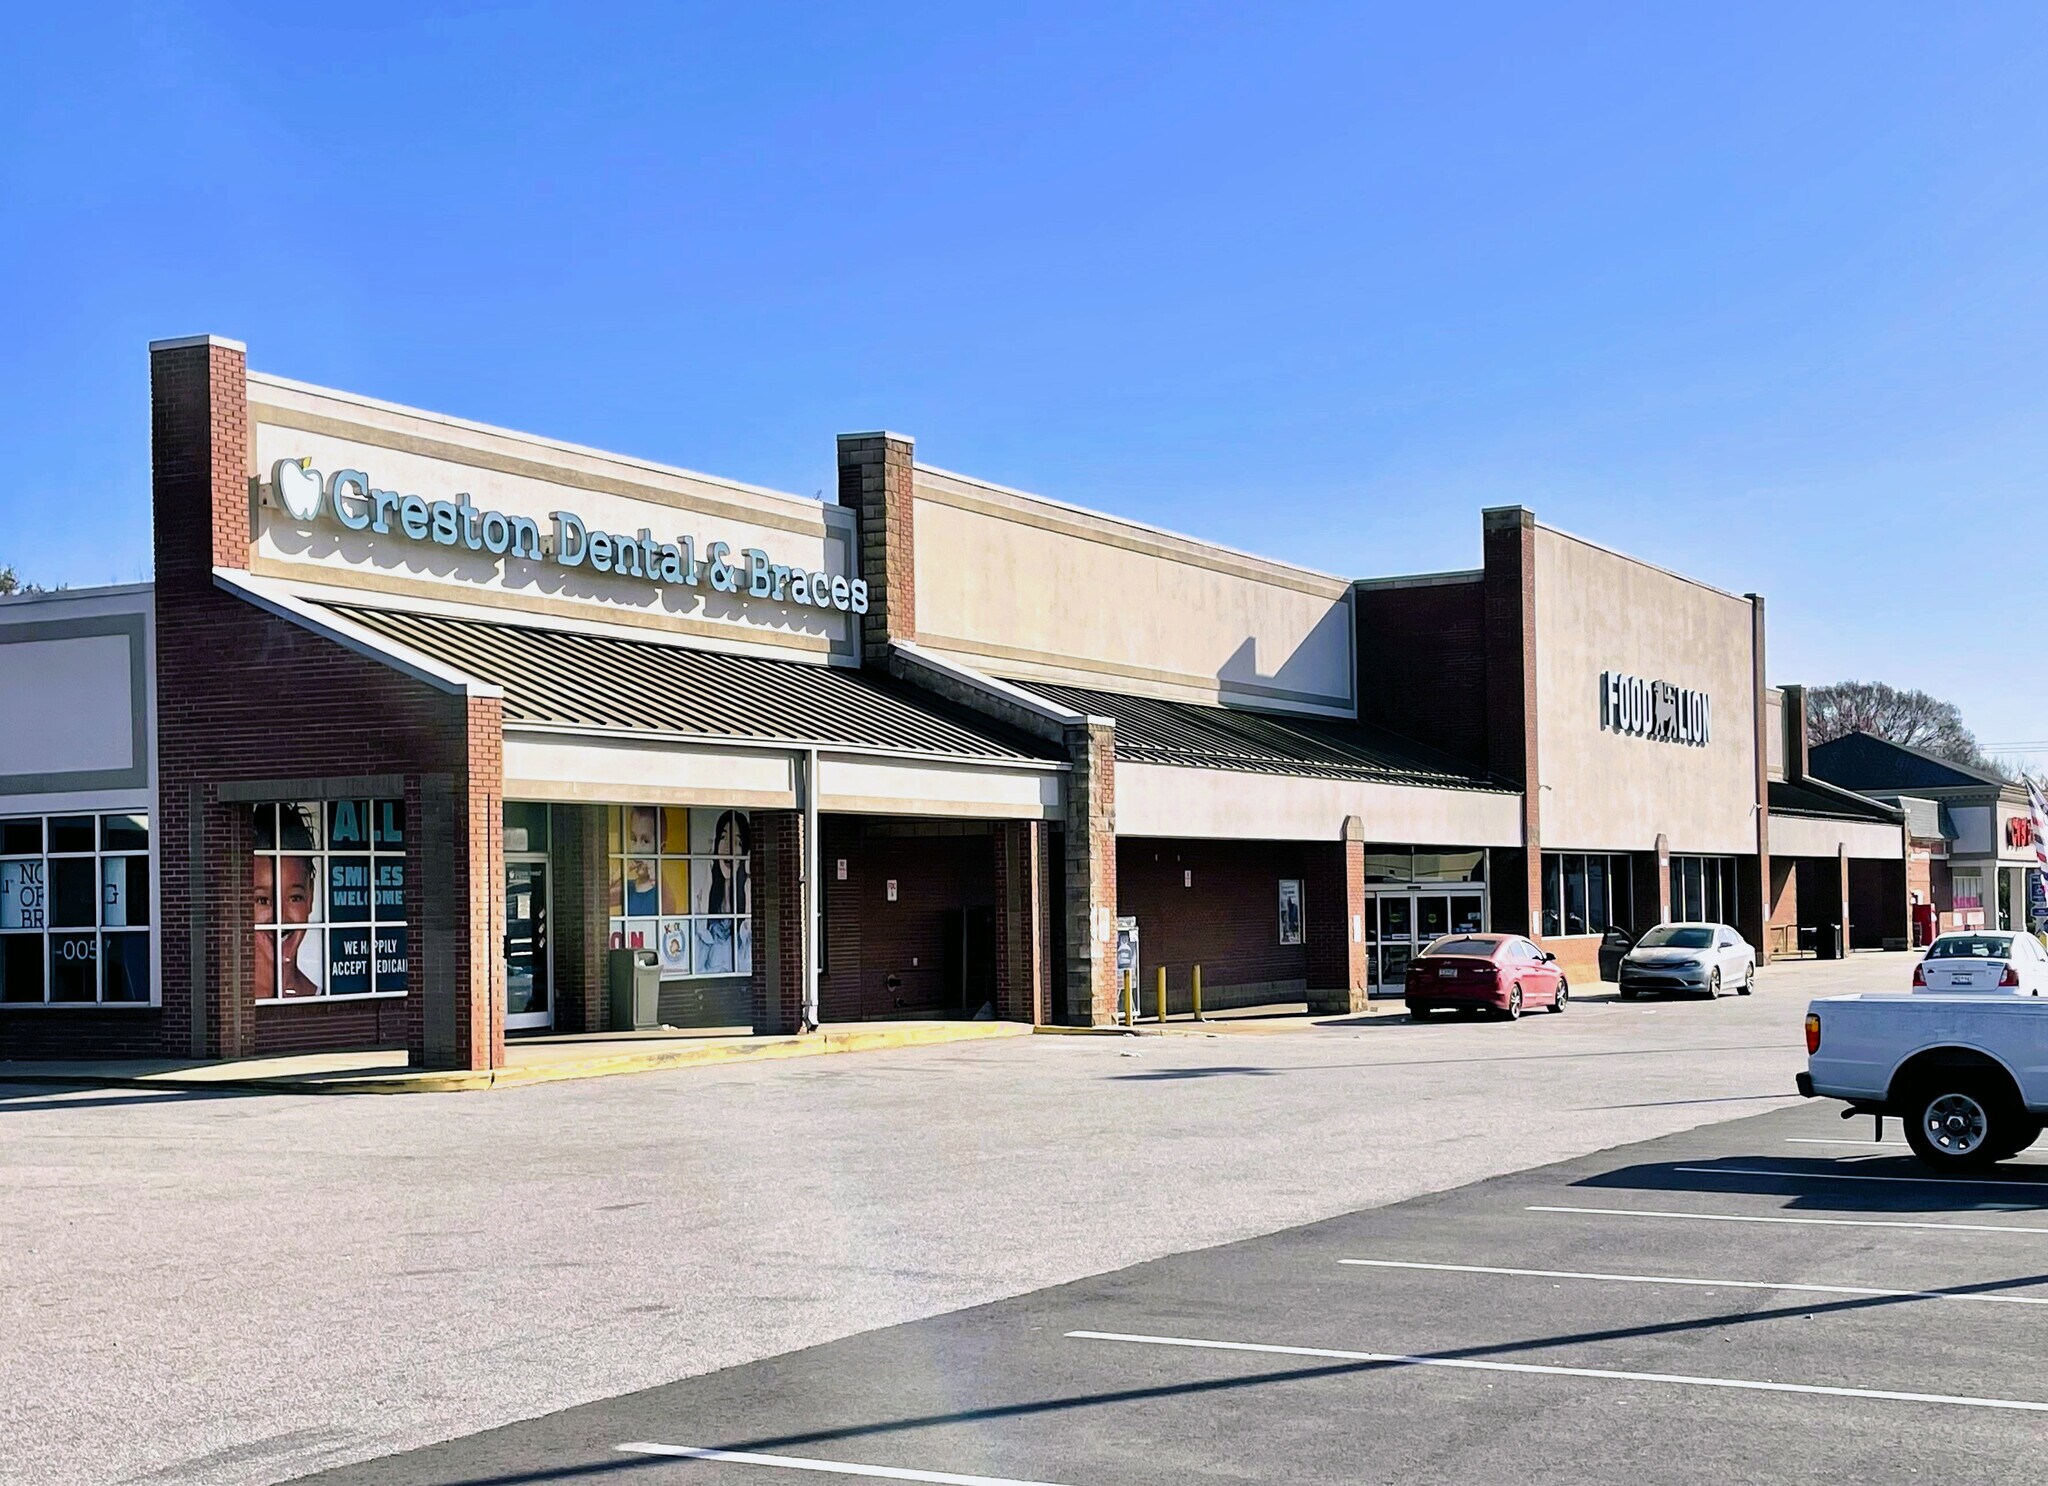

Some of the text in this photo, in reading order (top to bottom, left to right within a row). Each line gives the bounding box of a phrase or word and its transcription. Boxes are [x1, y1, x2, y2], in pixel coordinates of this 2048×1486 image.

[328, 469, 869, 614] Creston Dental & Braces
[1602, 671, 1710, 744] FOOD LION
[333, 801, 402, 842] ALL
[332, 958, 408, 976] ACCEPT EDICAI
[343, 940, 358, 955] WE
